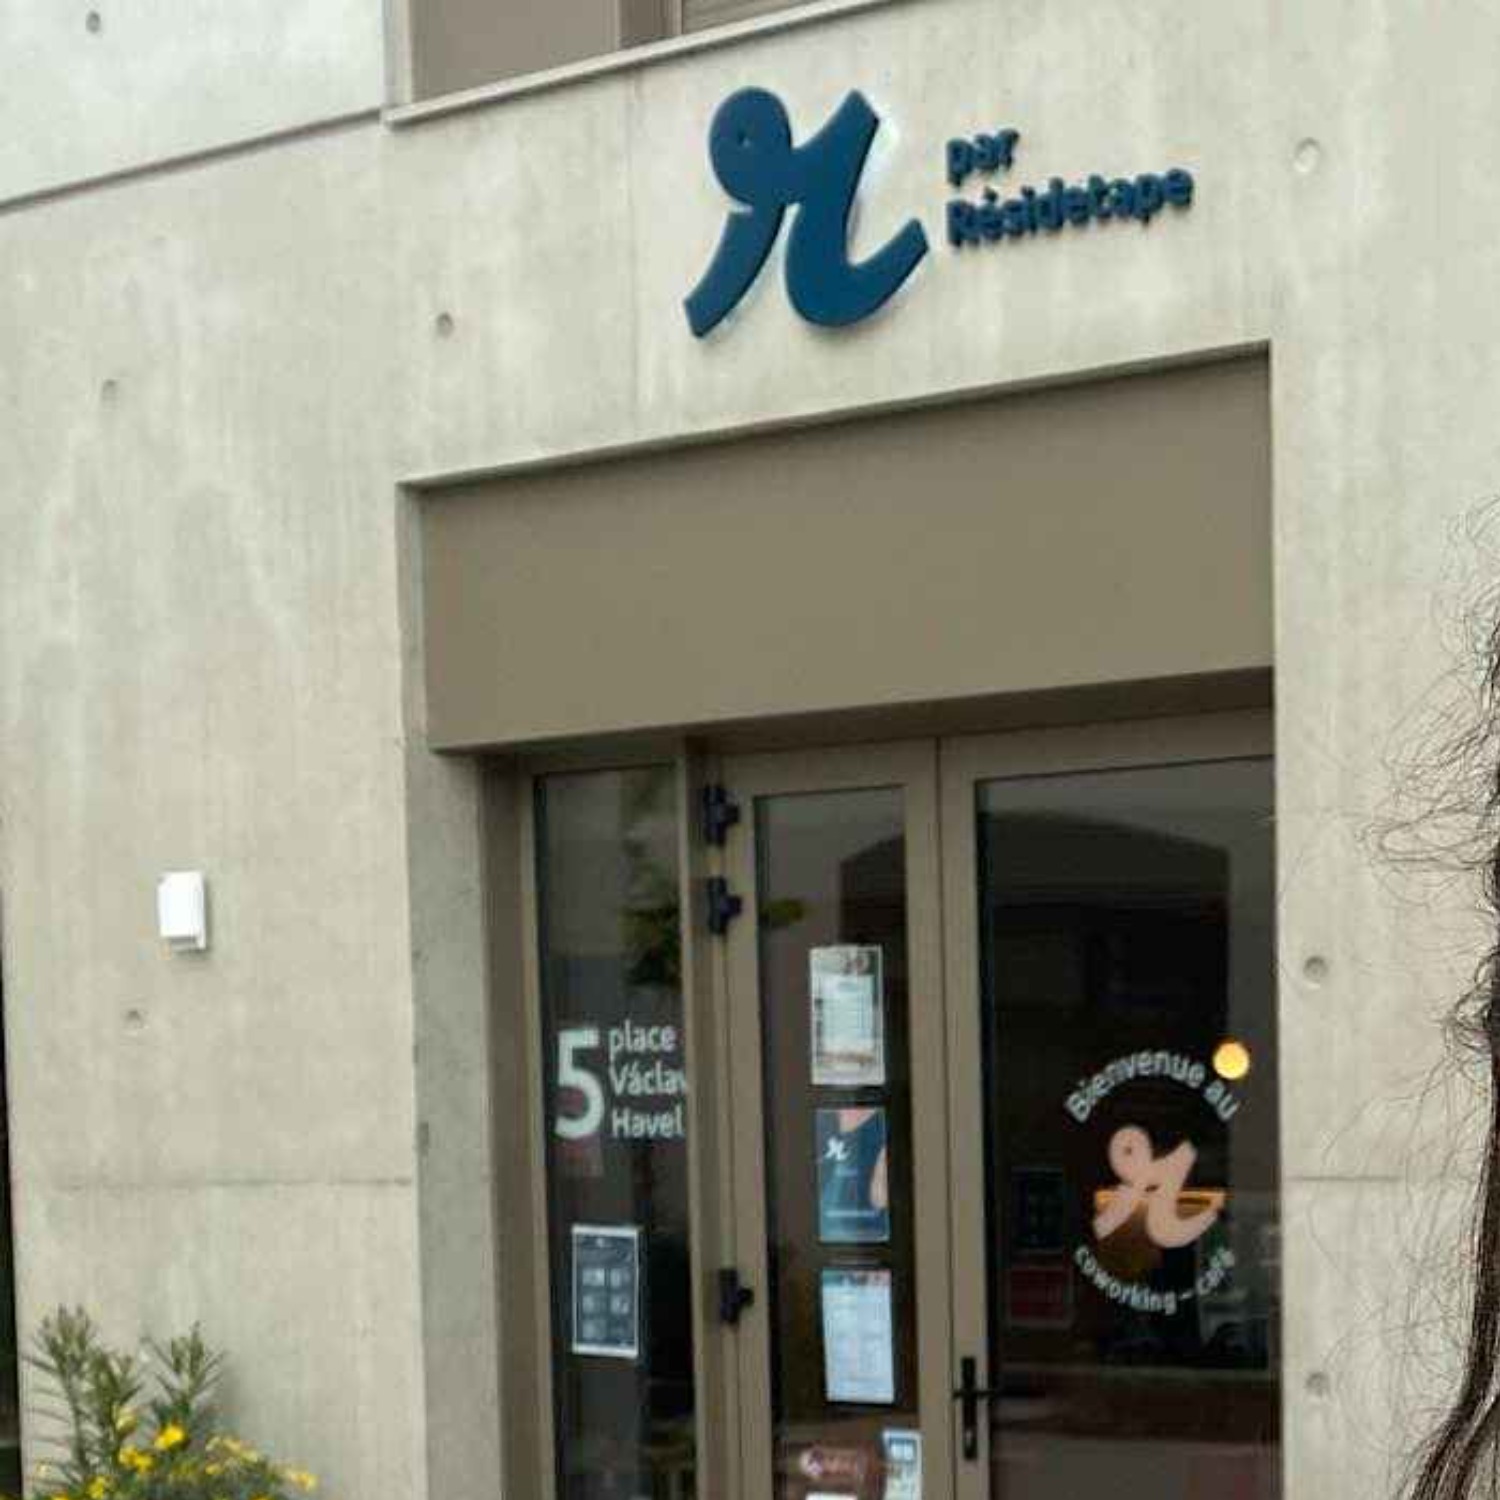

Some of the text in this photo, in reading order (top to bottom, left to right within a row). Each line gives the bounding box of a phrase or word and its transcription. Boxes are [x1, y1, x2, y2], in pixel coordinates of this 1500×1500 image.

[946, 128, 1020, 187] par
[946, 169, 1195, 248] Résidetape
[608, 1019, 677, 1062] place
[554, 1028, 605, 1139] 5
[1066, 1050, 1239, 1122] Bienvenue au
[612, 1105, 683, 1138] Havel
